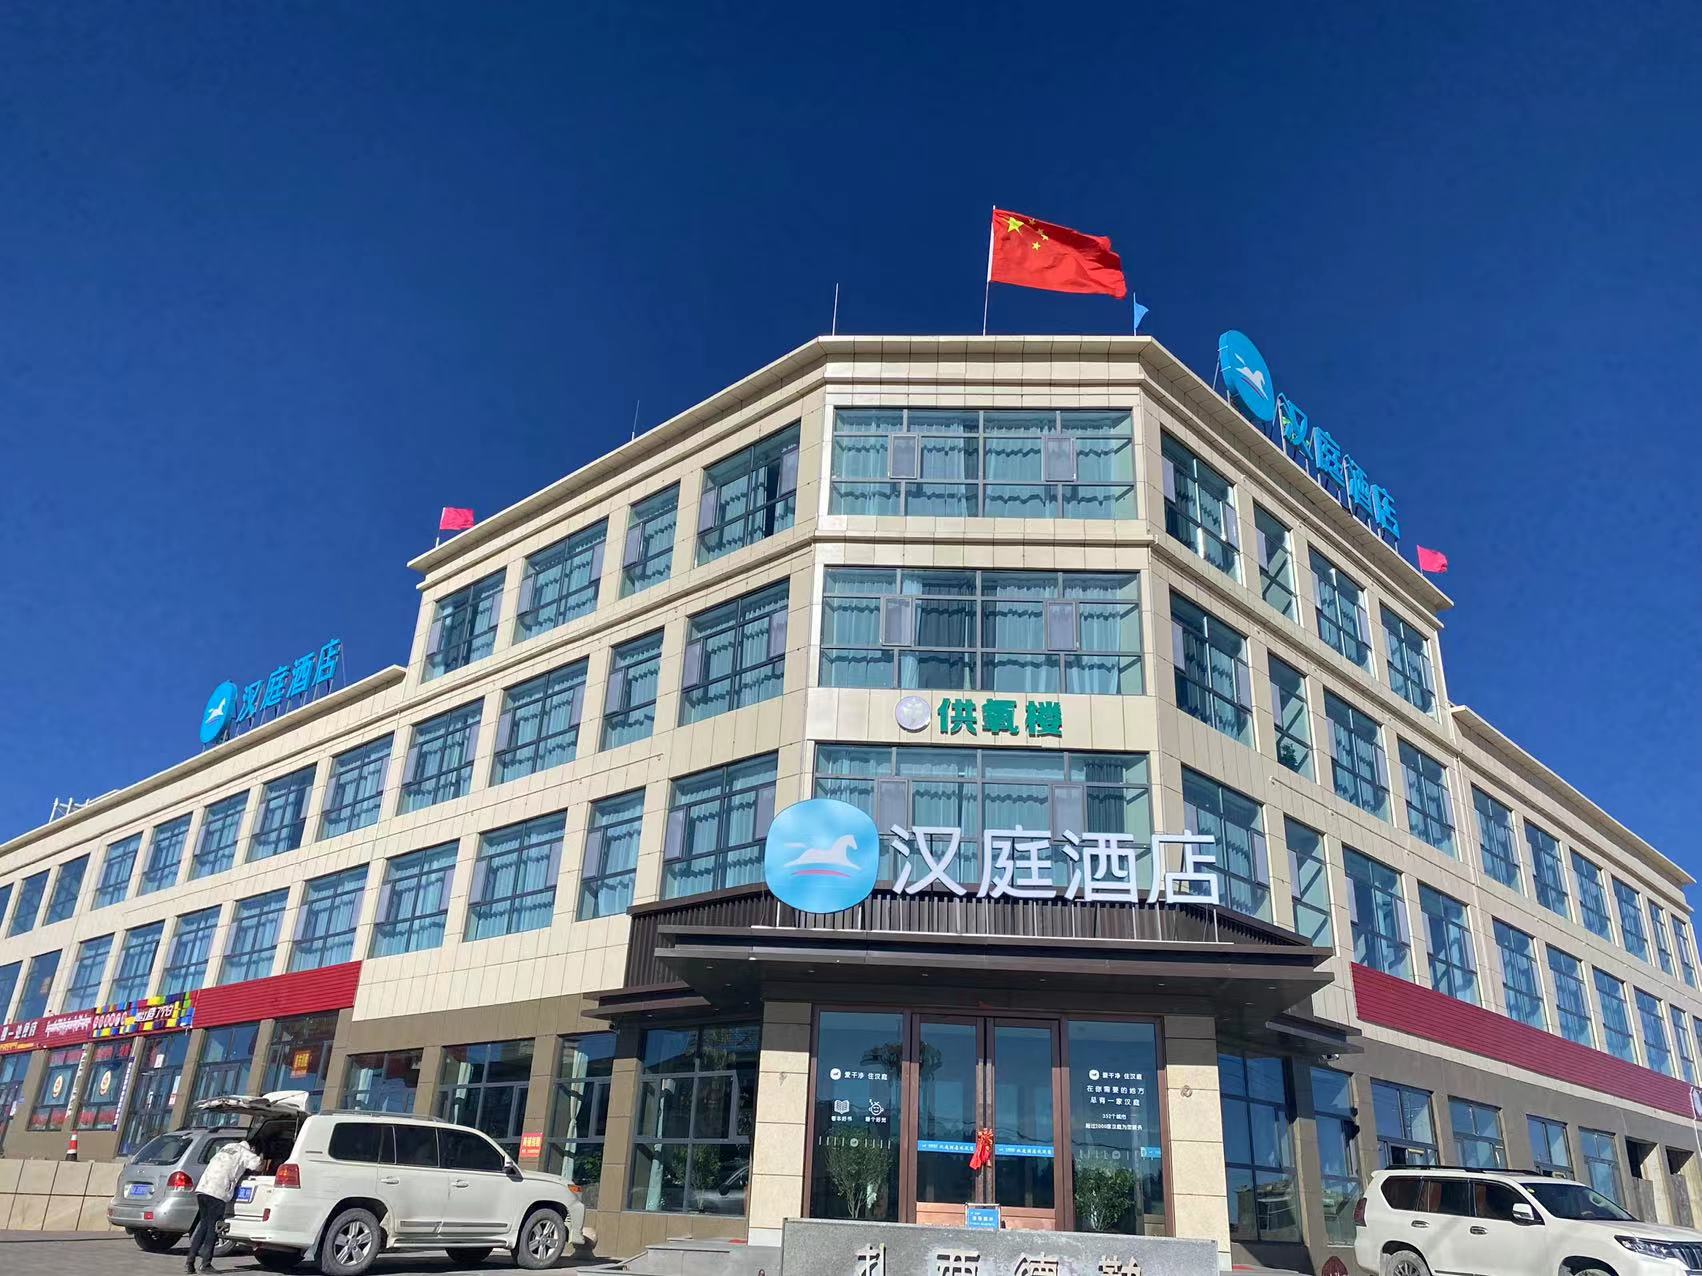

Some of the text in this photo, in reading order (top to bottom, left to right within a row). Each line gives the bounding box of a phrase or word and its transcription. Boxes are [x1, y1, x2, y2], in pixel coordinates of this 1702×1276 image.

[1281, 396, 1400, 540] 汉庭酒店
[235, 638, 341, 723] 汉庭酒店
[937, 697, 1063, 738] 供氧楼
[889, 823, 1220, 906] 汉庭酒店
[867, 1073, 888, 1081] 住汉庭
[1090, 1096, 1140, 1106] 总有一家汉庭
